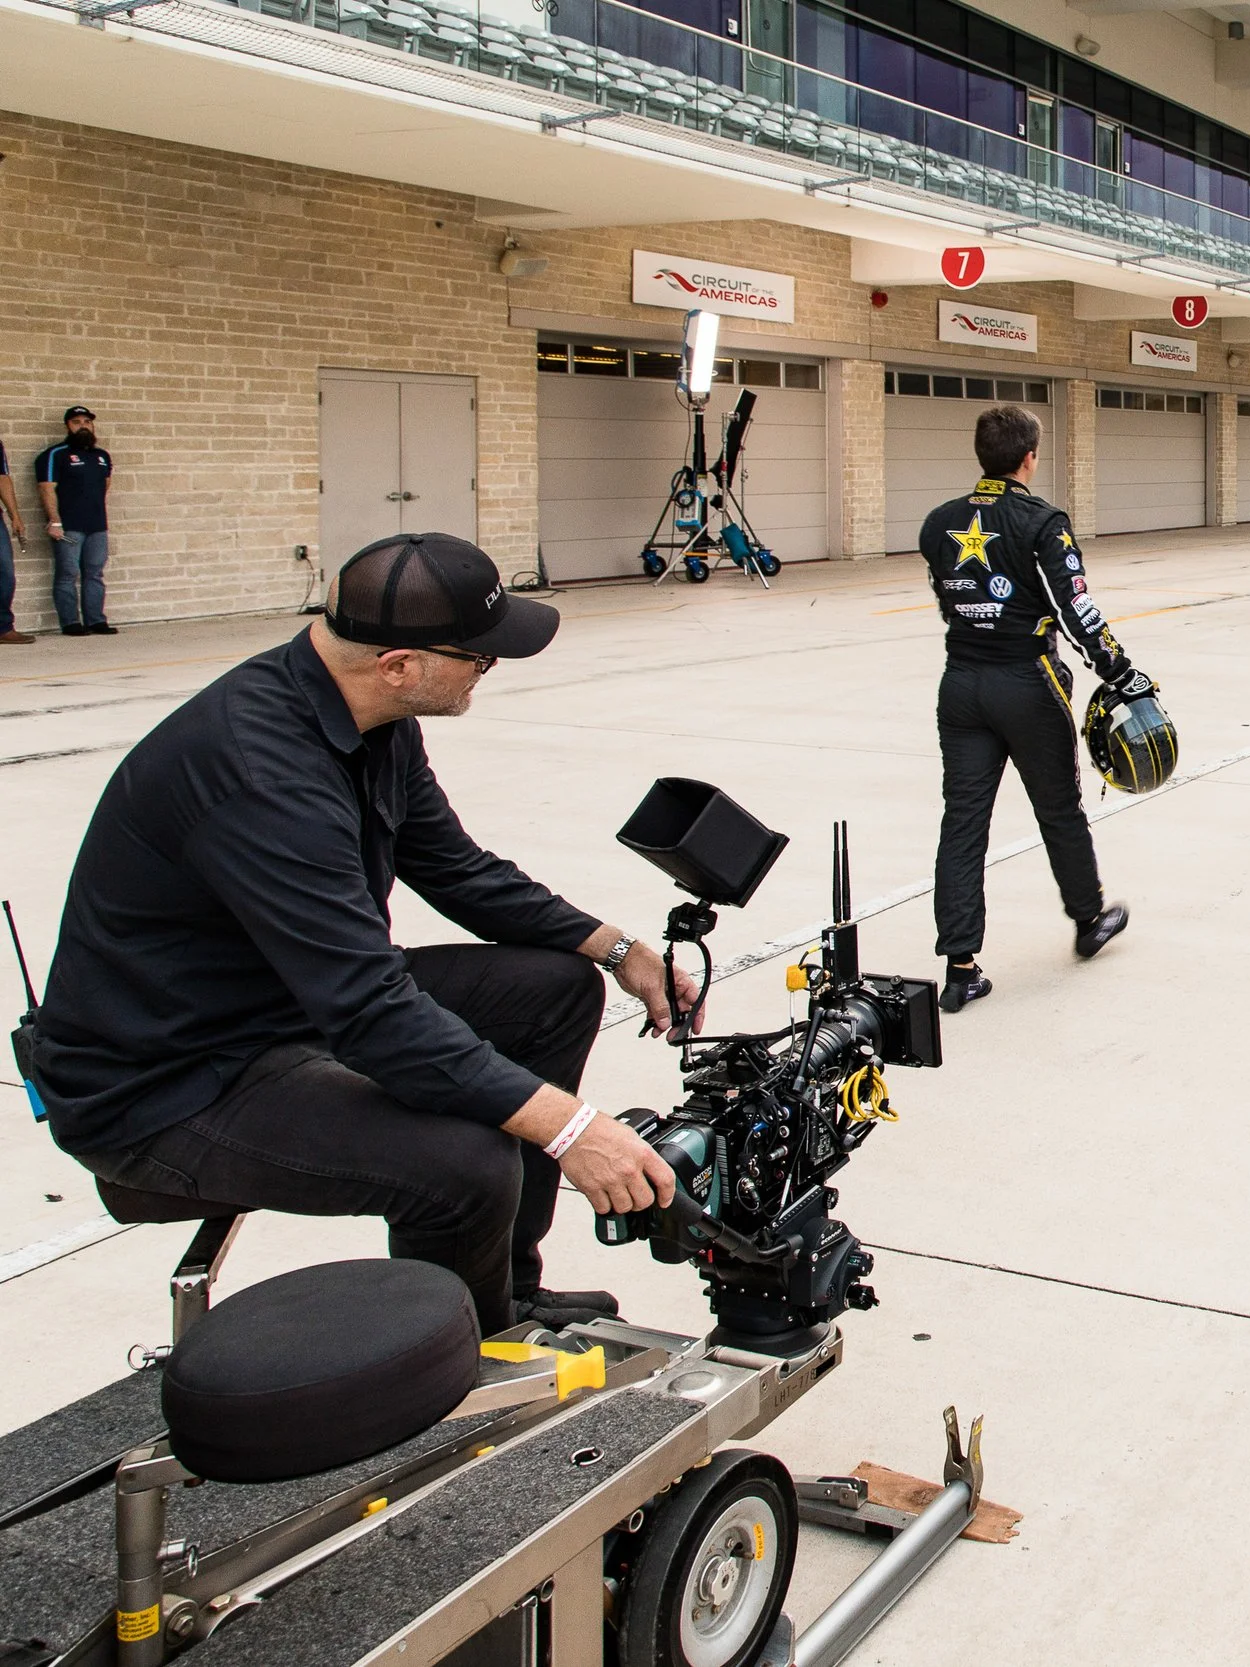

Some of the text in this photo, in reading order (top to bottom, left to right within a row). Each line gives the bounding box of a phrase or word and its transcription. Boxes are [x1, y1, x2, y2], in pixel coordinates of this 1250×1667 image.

[958, 252, 970, 279] 7
[692, 274, 752, 292] CIRCUIT
[698, 288, 778, 308] AMERICAS
[1185, 299, 1195, 321] 8
[974, 316, 1011, 329] CIRCUIT
[978, 327, 1027, 340] AMERICAS
[1155, 343, 1180, 353] CIRCUIT
[1157, 352, 1191, 362] AMERICAS
[955, 602, 1004, 612] ODYSSEY
[693, 1164, 712, 1182] ANTON
